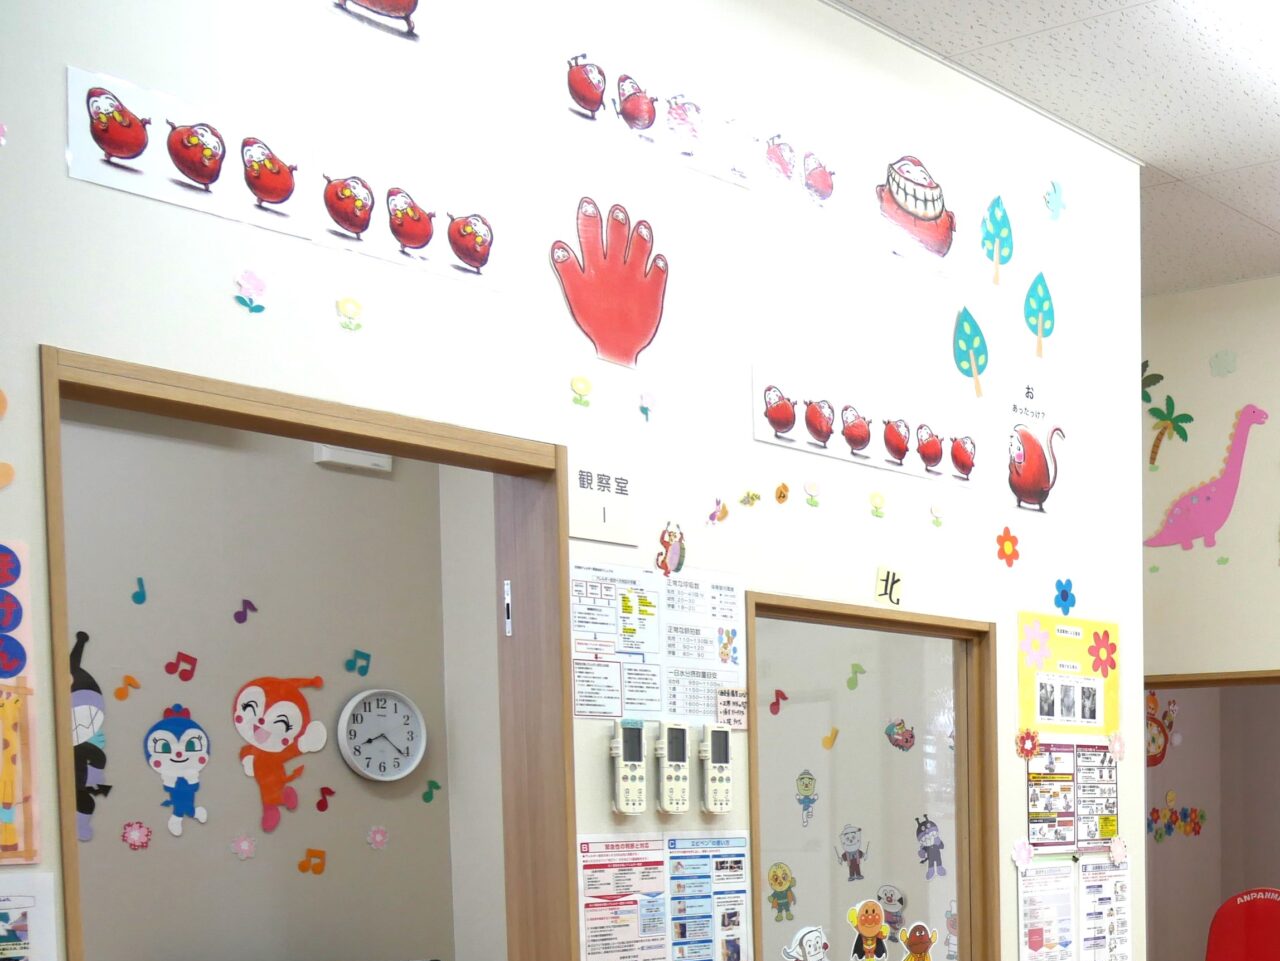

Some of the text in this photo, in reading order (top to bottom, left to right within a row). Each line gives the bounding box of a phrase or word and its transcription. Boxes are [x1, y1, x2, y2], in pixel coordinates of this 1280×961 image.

[1025, 385, 1034, 399] お
[578, 470, 629, 496] 観察室
[878, 570, 901, 605] 北
[363, 702, 372, 712] 11
[376, 698, 387, 709] 12
[394, 702, 398, 714] 1
[352, 714, 364, 724] 10
[403, 714, 410, 726] 2
[348, 728, 357, 740] 9
[406, 730, 414, 742] 3
[354, 745, 361, 756] 8
[365, 757, 372, 768] 7
[378, 762, 386, 772] 6
[393, 758, 400, 768] 5
